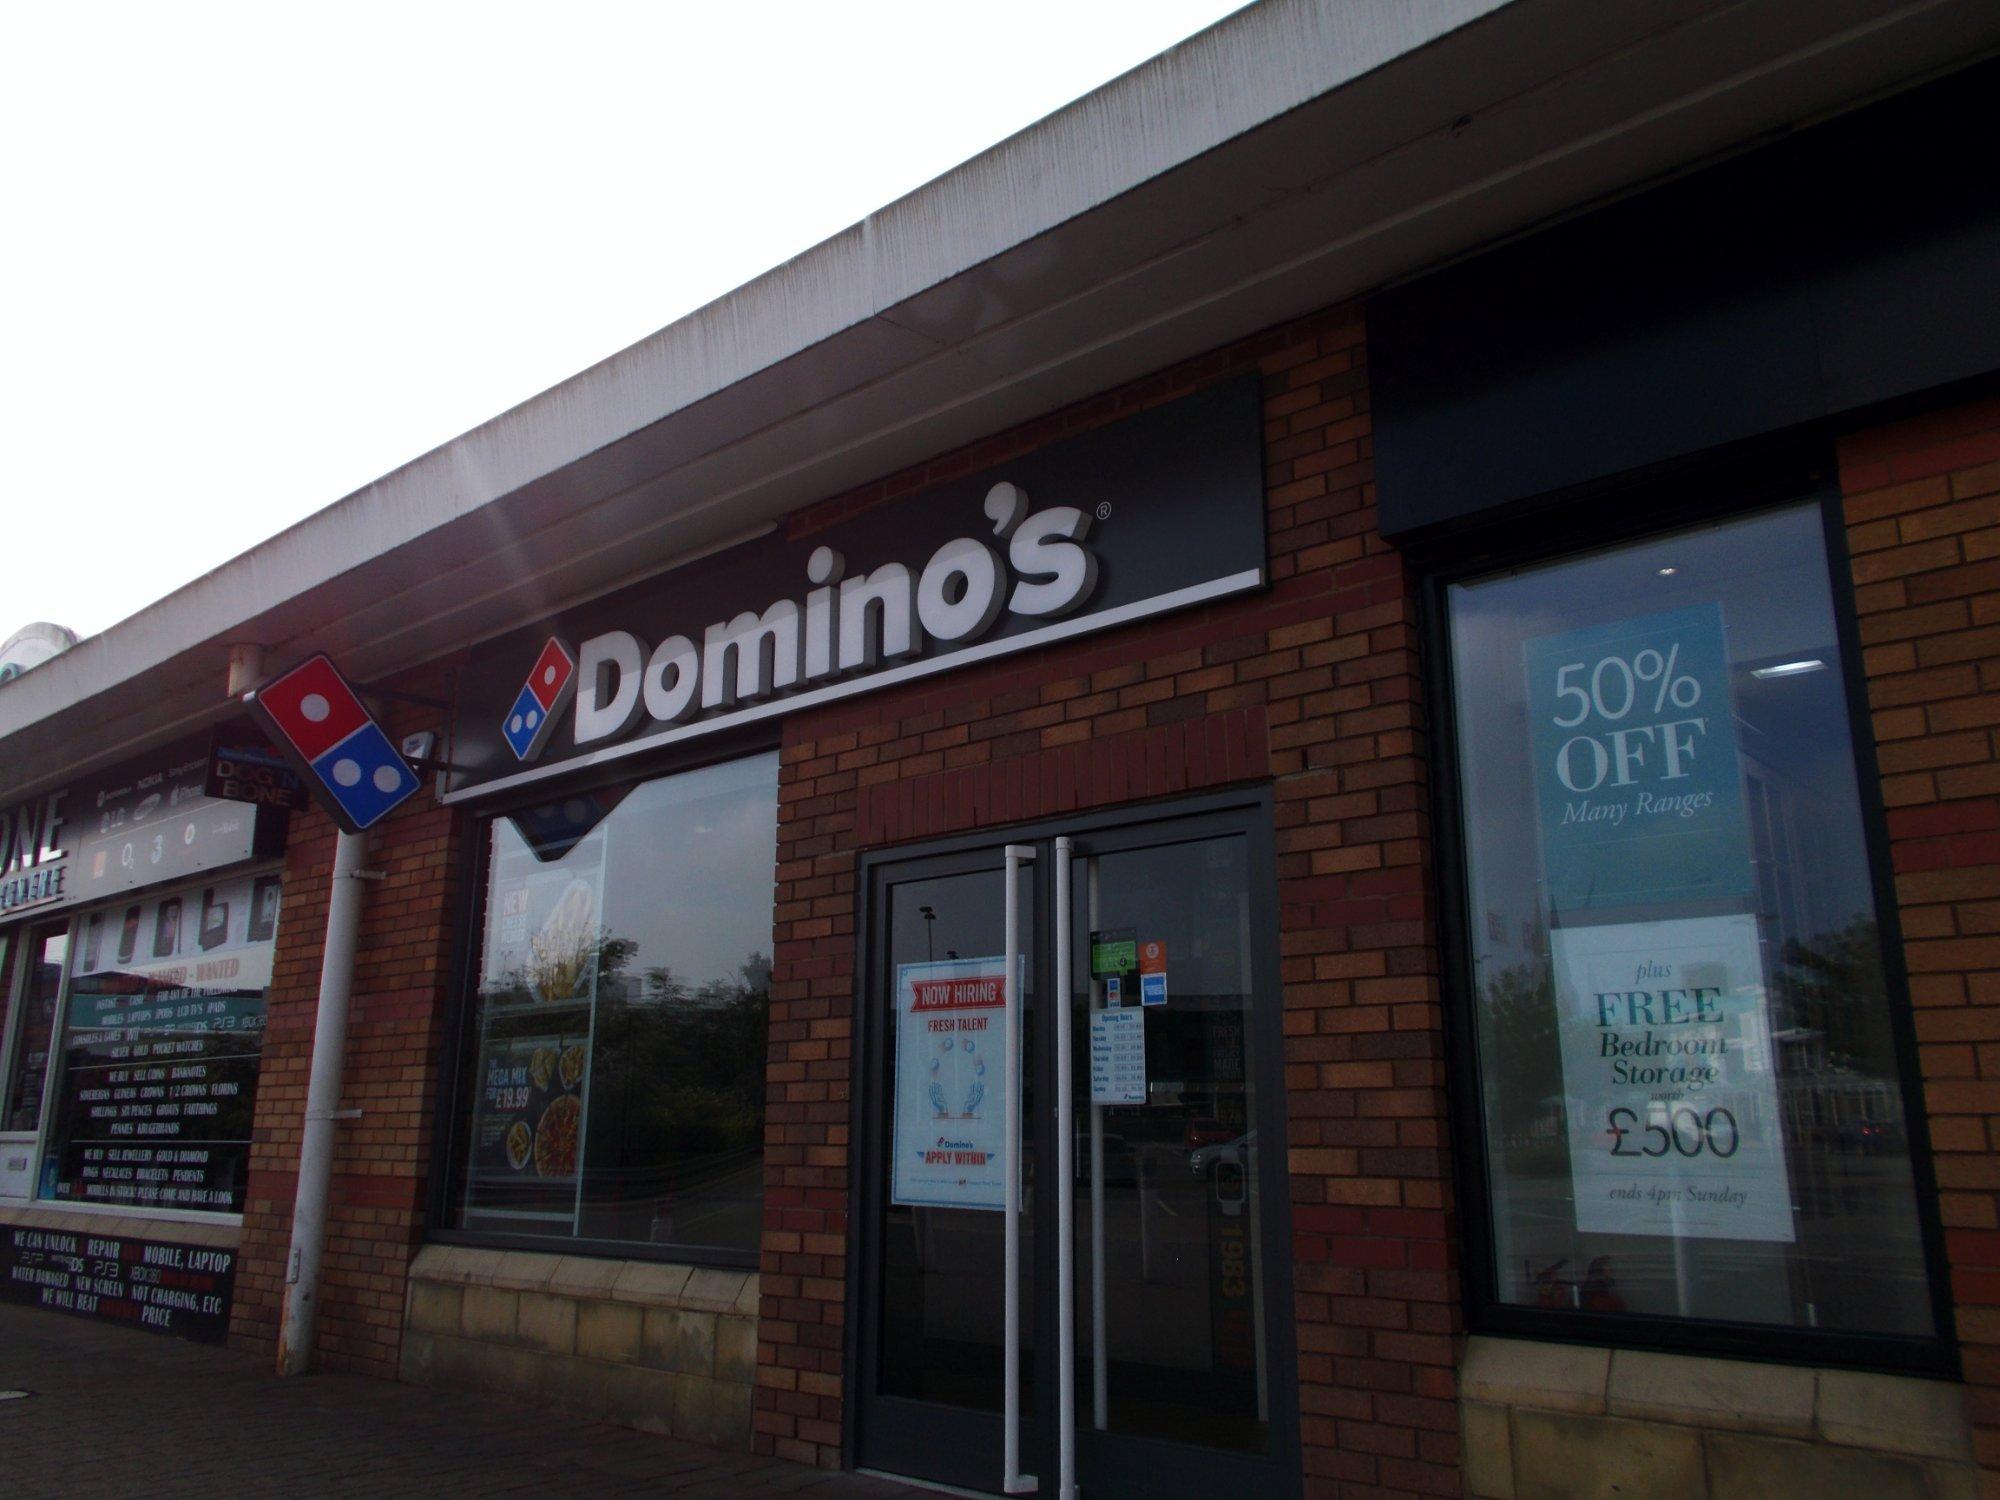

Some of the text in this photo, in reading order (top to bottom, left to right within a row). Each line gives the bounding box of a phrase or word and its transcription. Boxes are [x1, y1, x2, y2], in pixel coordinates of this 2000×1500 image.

[573, 481, 1099, 746] Domino's
[1552, 642, 1702, 728] 50%
[1556, 717, 1710, 793] OFF
[216, 760, 273, 785] DOG
[222, 780, 292, 807] BONE
[1560, 790, 1714, 826] Many Ranges
[196, 958, 240, 982] WANTED
[1636, 960, 1672, 984] plus
[921, 982, 997, 1006] NOW HIRING
[1102, 1013, 1133, 1023] Opening Hours
[1593, 986, 1724, 1027] FREE
[928, 1017, 989, 1033] FRESH TALENT
[73, 1033, 99, 1047] CONSOLES
[153, 1042, 176, 1055] POCKET
[177, 1040, 205, 1053] WATCHES
[1600, 1031, 1728, 1058] Bedroom
[171, 1065, 207, 1078] BANKNOTES
[487, 1066, 528, 1086] MEGA MIX
[1613, 1059, 1720, 1091] Storage
[140, 1086, 165, 1098] CROWNS
[211, 1082, 239, 1096] FLORINS
[156, 1104, 180, 1116] GROATS
[184, 1102, 219, 1115] FARTHINGS
[1606, 1106, 1739, 1158] £500
[108, 1149, 121, 1162] SELL
[156, 1150, 172, 1163] GOLD
[179, 1151, 209, 1164] DIAMOND
[944, 1140, 974, 1149] Domino's
[925, 1151, 986, 1166] APPLY WITHIN
[102, 1166, 133, 1179] NECKLACES
[136, 1167, 169, 1181] BRACELETS
[214, 1191, 233, 1205] LOOK
[1609, 1182, 1643, 1200] ends
[1685, 1183, 1748, 1206] Sunday
[13, 1230, 26, 1246] WE
[27, 1232, 43, 1249] CAN
[44, 1234, 78, 1253] UNLOCK
[87, 1238, 119, 1260] REPAIR
[143, 1245, 184, 1270] MOBILE,
[187, 1251, 231, 1274] LAPTOP
[12, 1265, 34, 1281] WATER
[35, 1268, 69, 1287] DAMAGED
[74, 1273, 92, 1291] NEW
[93, 1279, 124, 1298] SCREEN
[131, 1283, 149, 1302] NOT
[203, 1295, 222, 1315] ETC
[41, 1287, 53, 1304] WE
[55, 1290, 74, 1309] WILL
[76, 1294, 99, 1313] BEAT
[141, 1306, 172, 1328] PRICE
